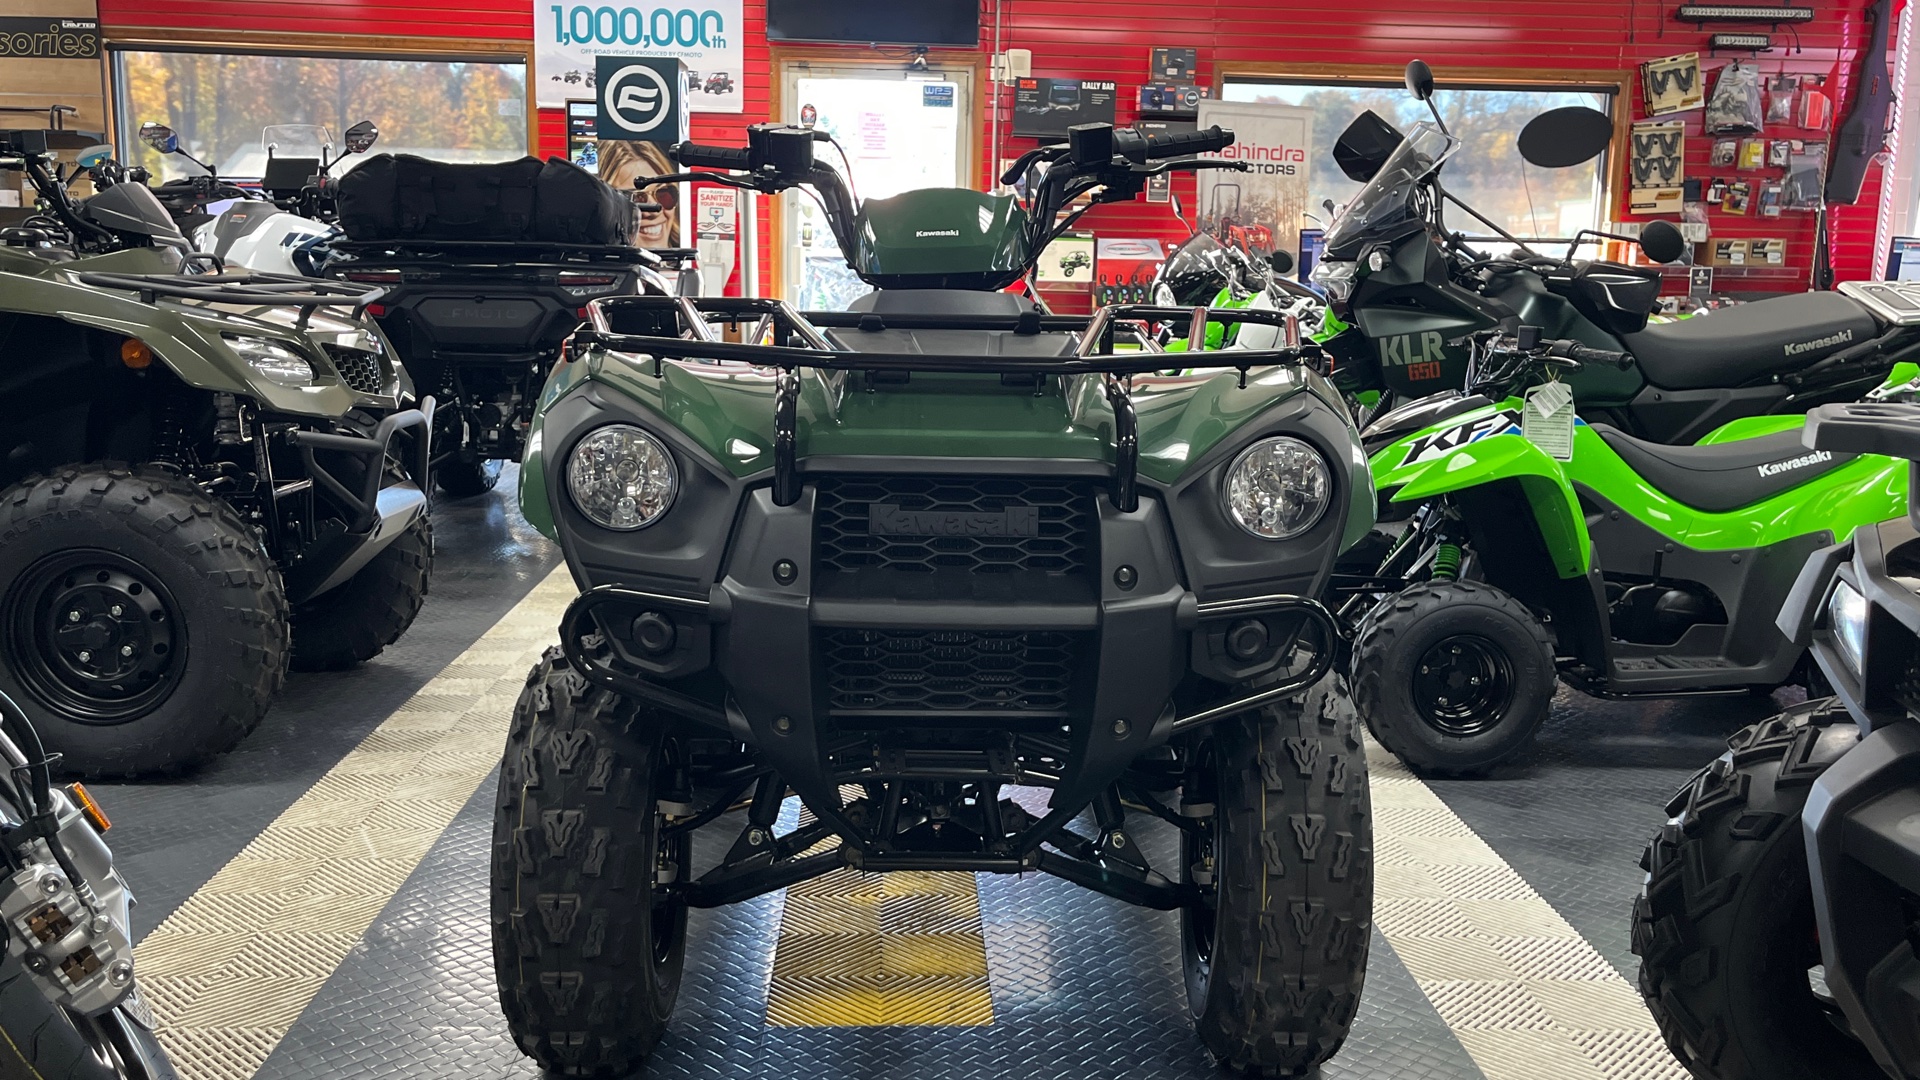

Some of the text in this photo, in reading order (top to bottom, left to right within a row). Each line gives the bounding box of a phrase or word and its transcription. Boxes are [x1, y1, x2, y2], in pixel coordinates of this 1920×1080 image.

[924, 87, 952, 95] WPS
[1082, 82, 1115, 90] RALLY BAR
[700, 194, 734, 202] SANITIZE
[1379, 331, 1446, 367] KLR
[1784, 329, 1853, 356] Kawasaki
[1408, 361, 1441, 381] 650
[1758, 450, 1832, 478] Kawasaki
[870, 505, 1038, 537] Kawasaki
